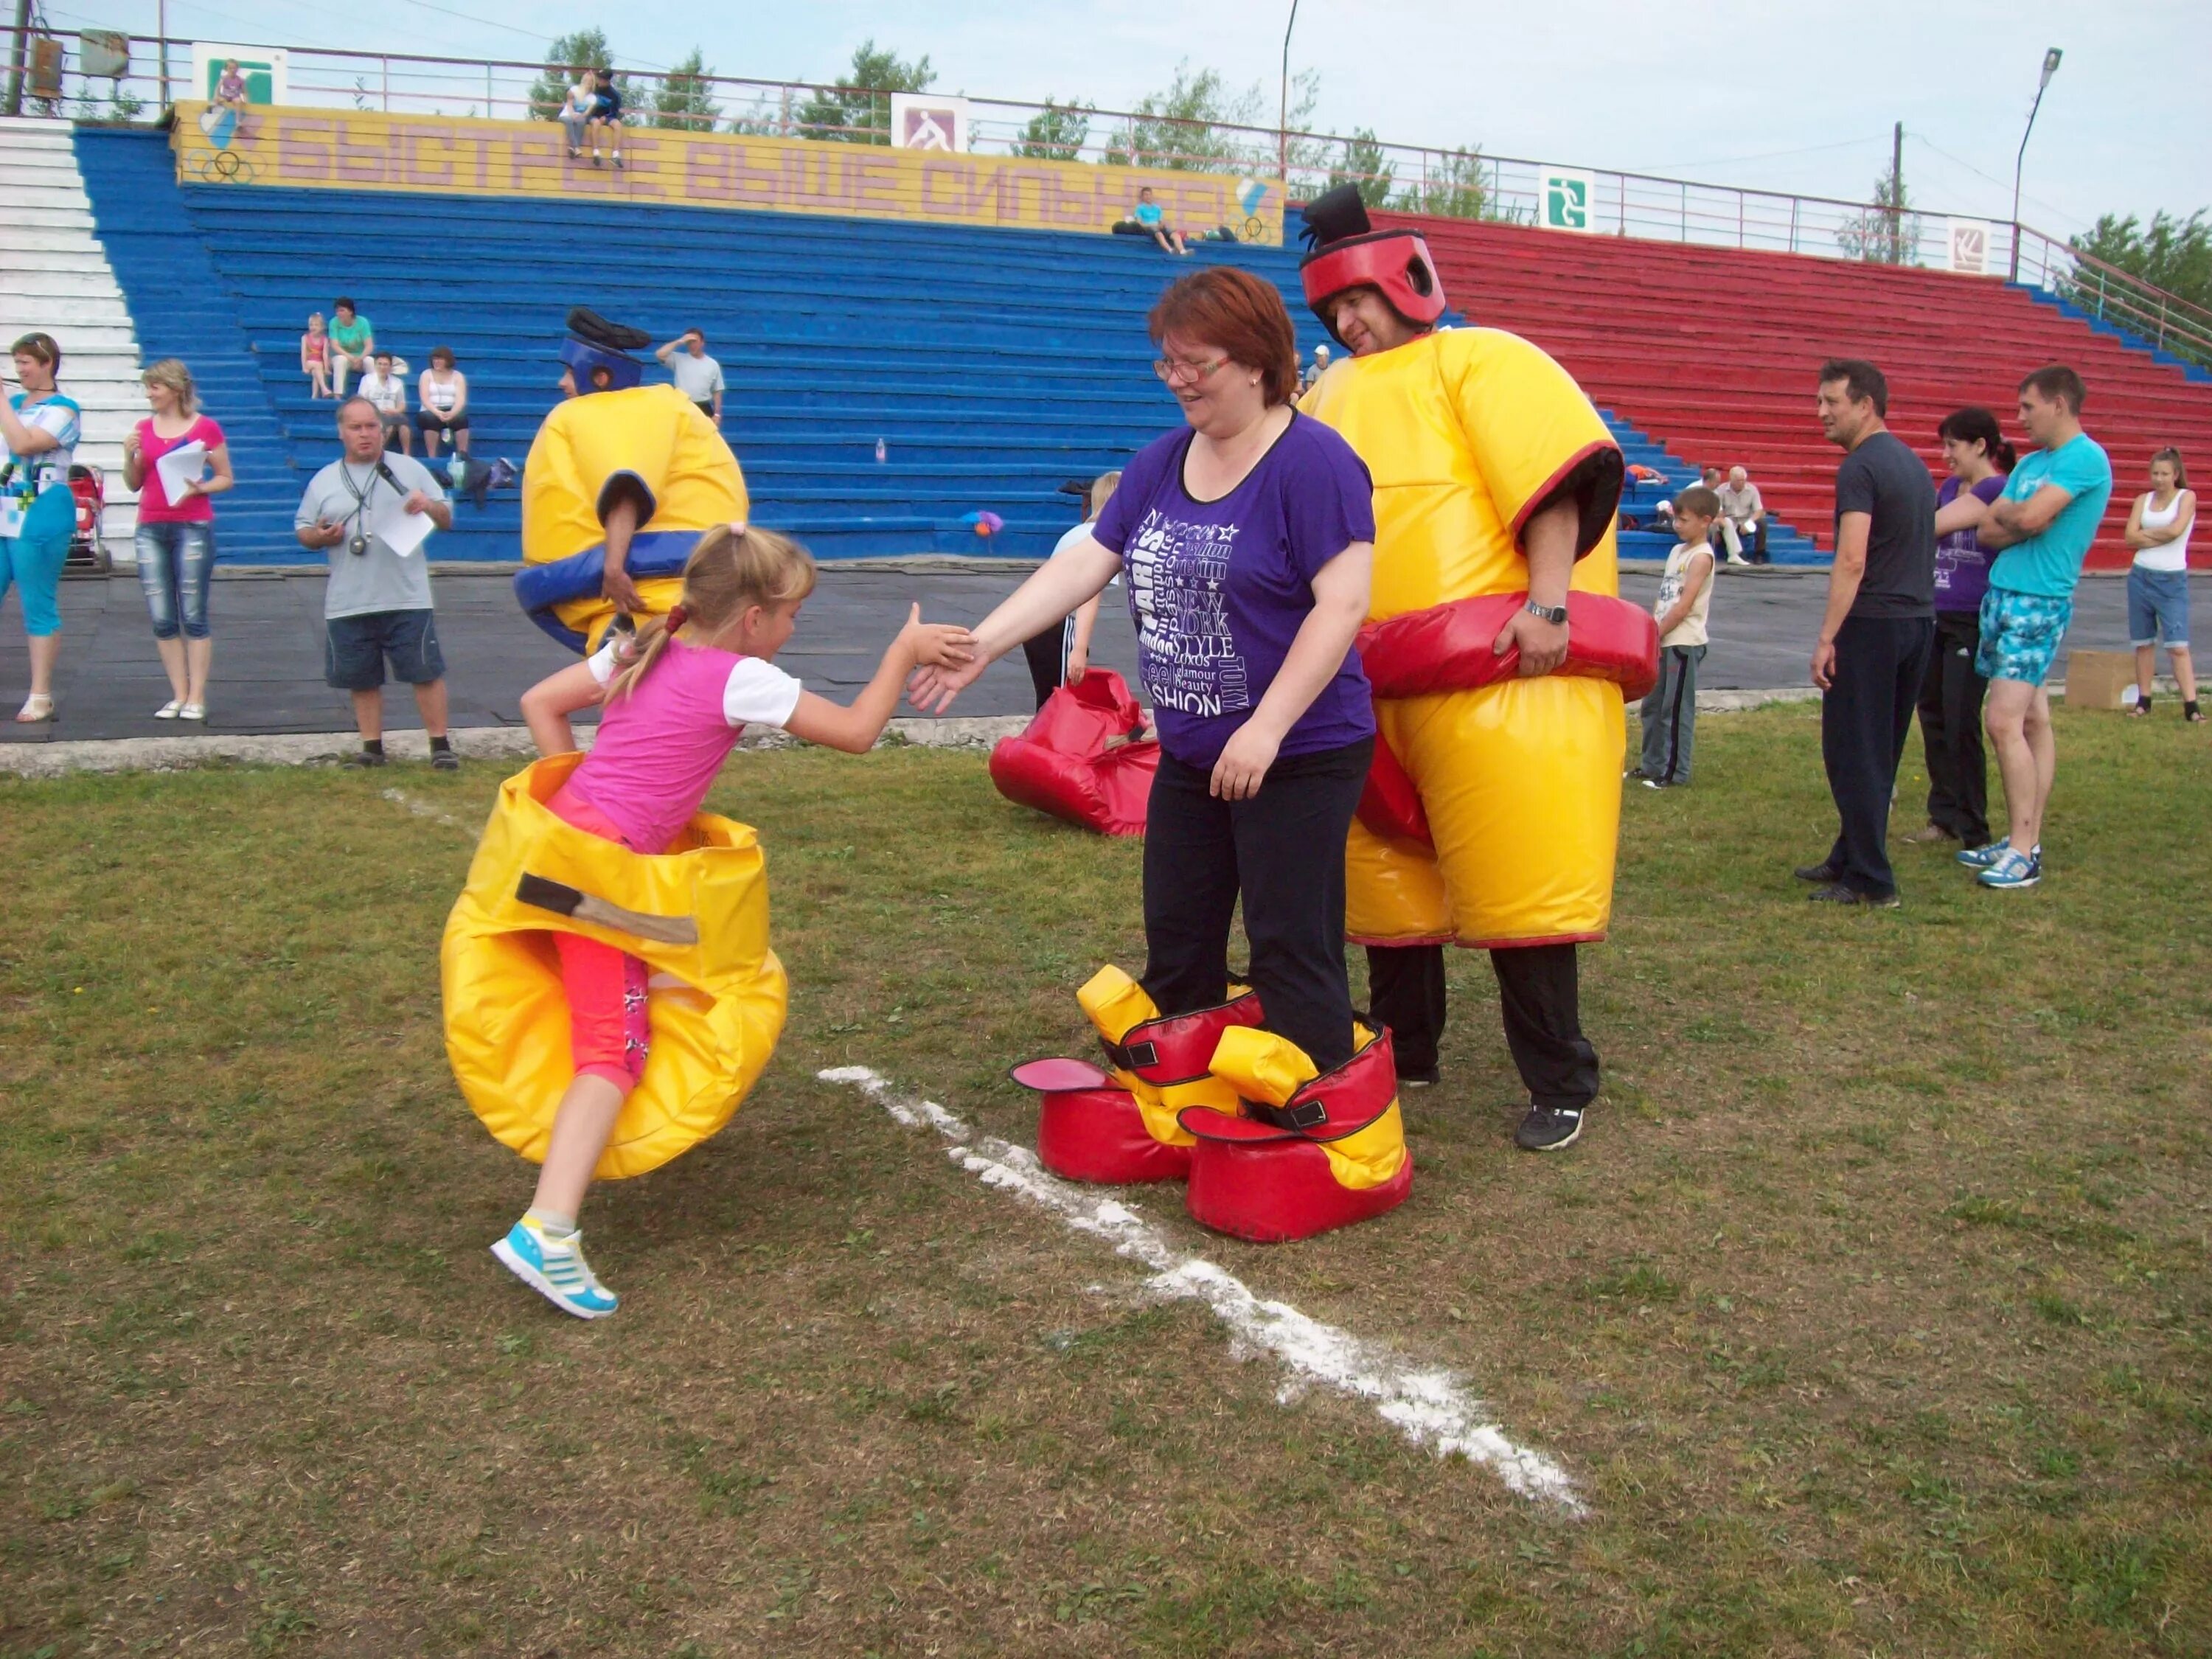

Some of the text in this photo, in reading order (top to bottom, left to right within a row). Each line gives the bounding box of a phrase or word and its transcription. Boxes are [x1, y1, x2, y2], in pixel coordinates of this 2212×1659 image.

[685, 142, 906, 214] ВЫШЕ,
[1131, 527, 1165, 630] PARIS
[1174, 556, 1227, 580] victim
[1153, 534, 1176, 634] mgapolice
[1164, 542, 1184, 632] passion
[1174, 588, 1225, 613] NEW
[1177, 605, 1231, 636] YORK
[1139, 625, 1174, 656] ondon
[1173, 633, 1235, 658] STYLE
[1143, 658, 1175, 689] eel
[1177, 664, 1216, 681] glamour
[1218, 656, 1250, 712] TOKY
